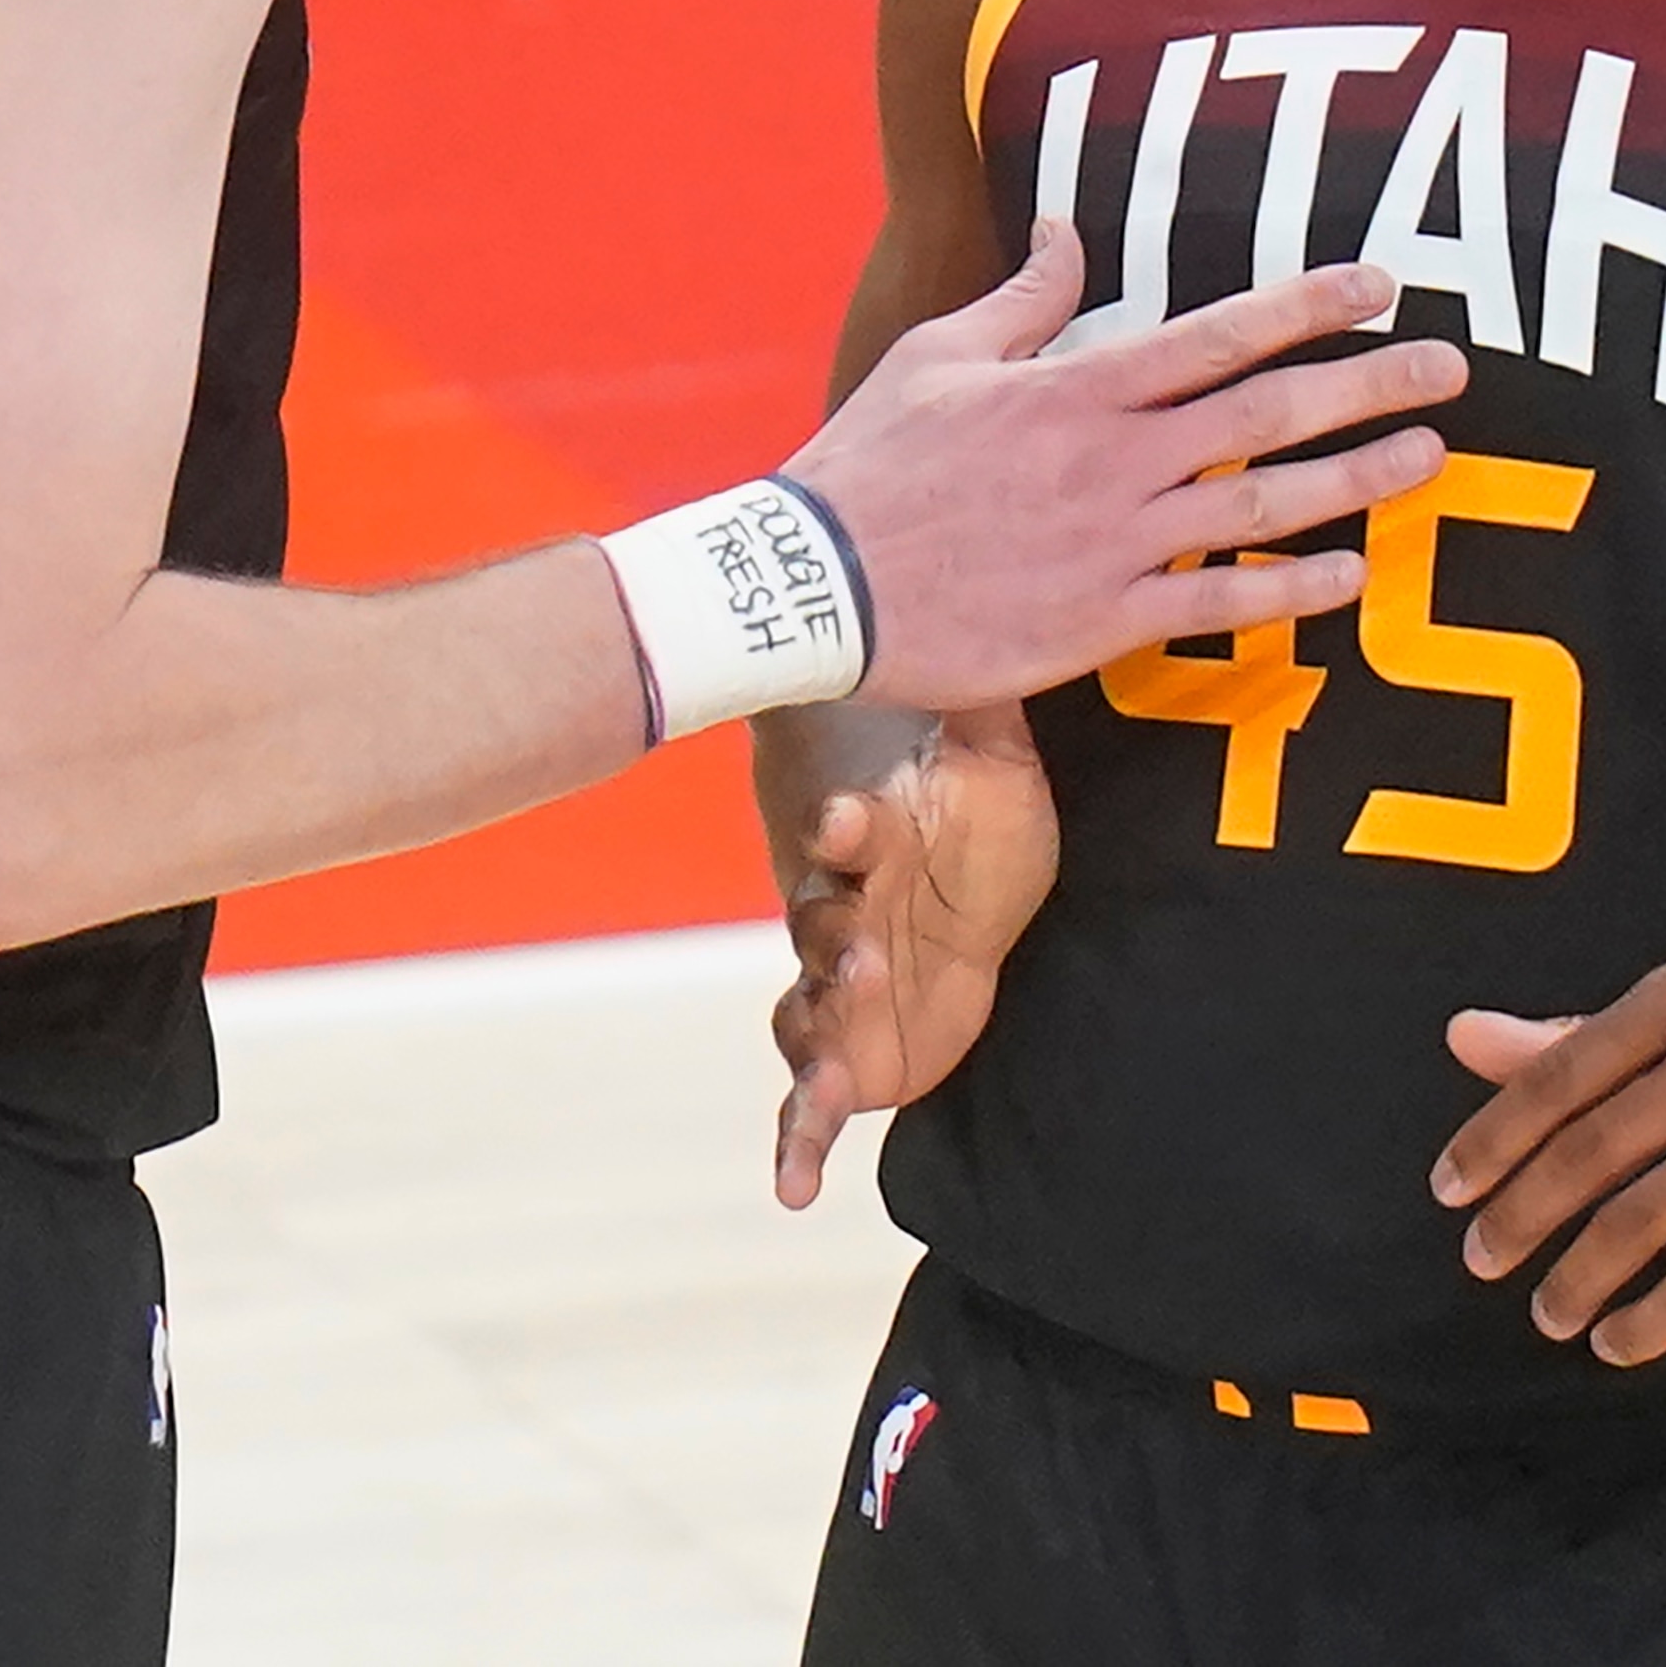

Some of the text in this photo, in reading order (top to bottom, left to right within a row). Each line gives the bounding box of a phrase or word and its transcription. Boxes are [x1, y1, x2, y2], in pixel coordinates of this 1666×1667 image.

[696, 516, 797, 654] FRESH
[739, 494, 842, 650] DOUGIE
[1098, 451, 1596, 874] 45
